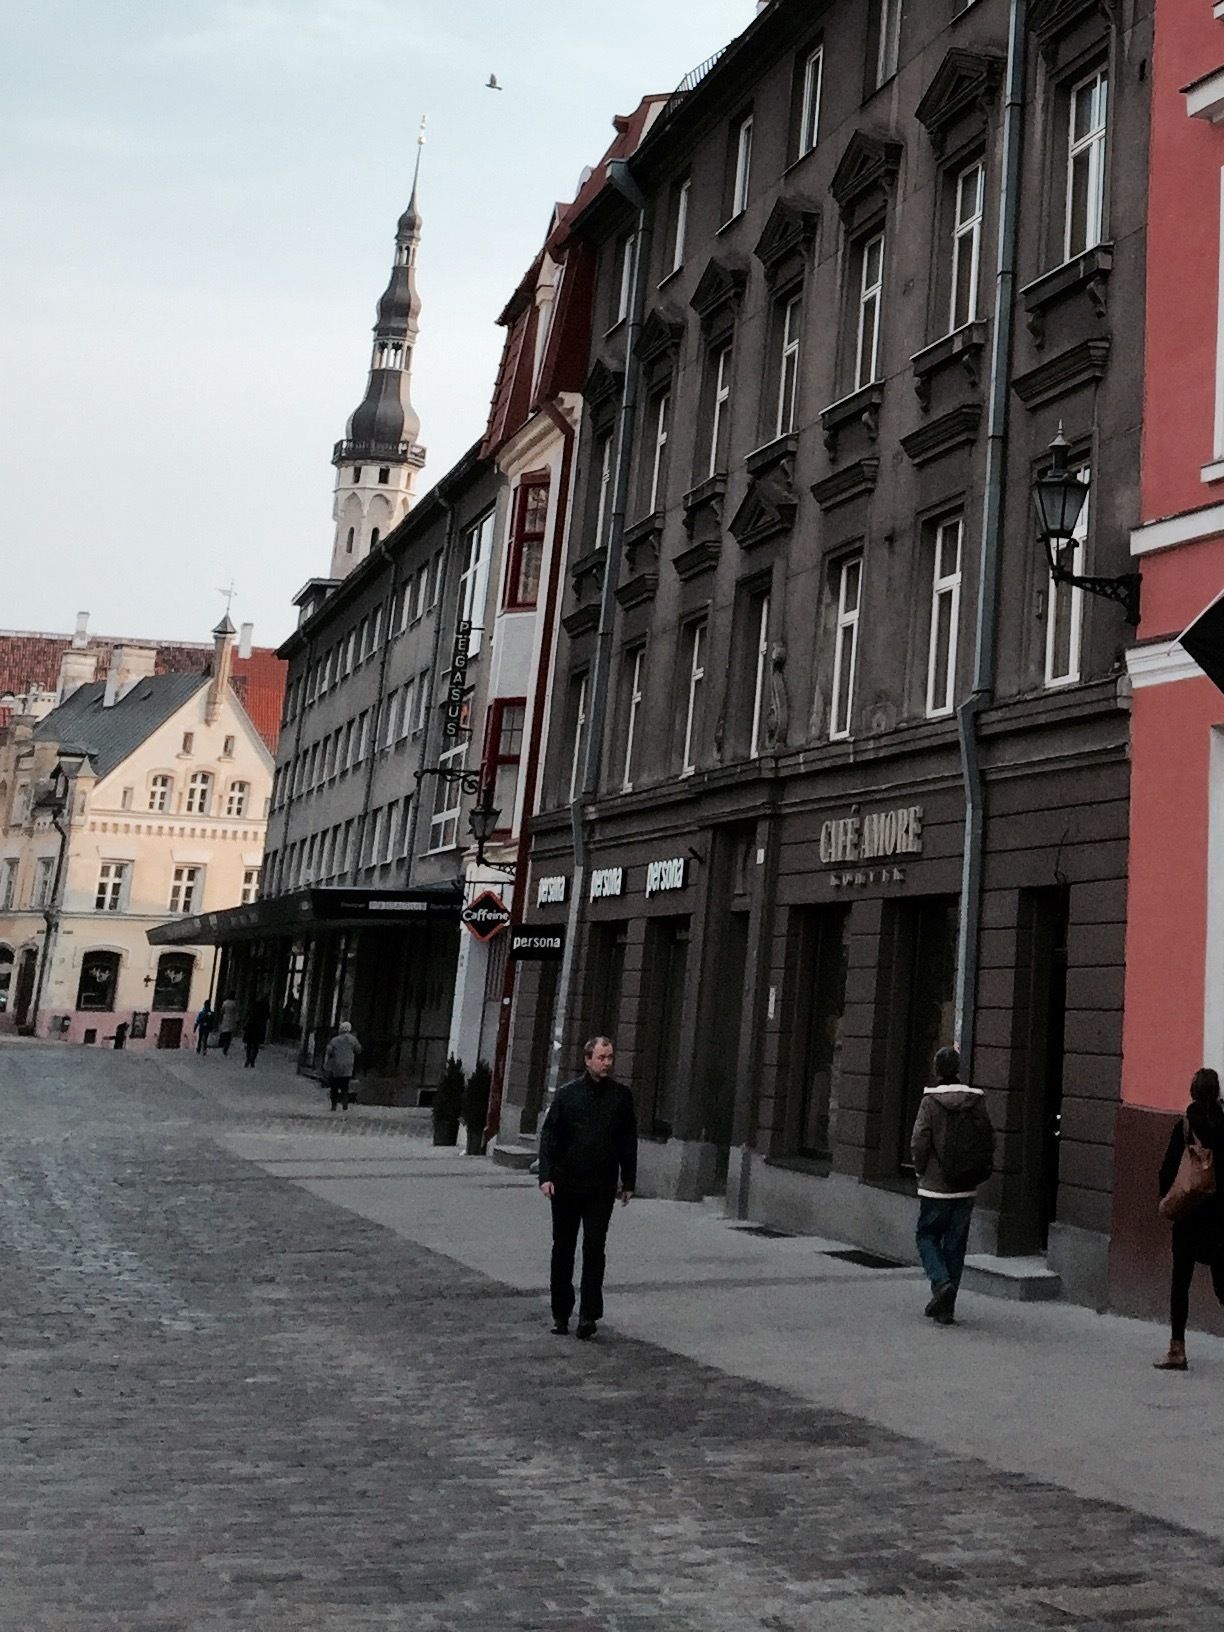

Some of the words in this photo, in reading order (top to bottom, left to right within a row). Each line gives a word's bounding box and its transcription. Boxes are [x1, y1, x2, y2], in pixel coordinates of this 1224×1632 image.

[447, 622, 469, 735] PEGASUS
[860, 805, 924, 859] AMORE
[537, 876, 566, 909] persona
[590, 867, 623, 904] persona
[646, 857, 685, 899] persona
[462, 908, 509, 922] Caffeine
[513, 936, 561, 949] persona
